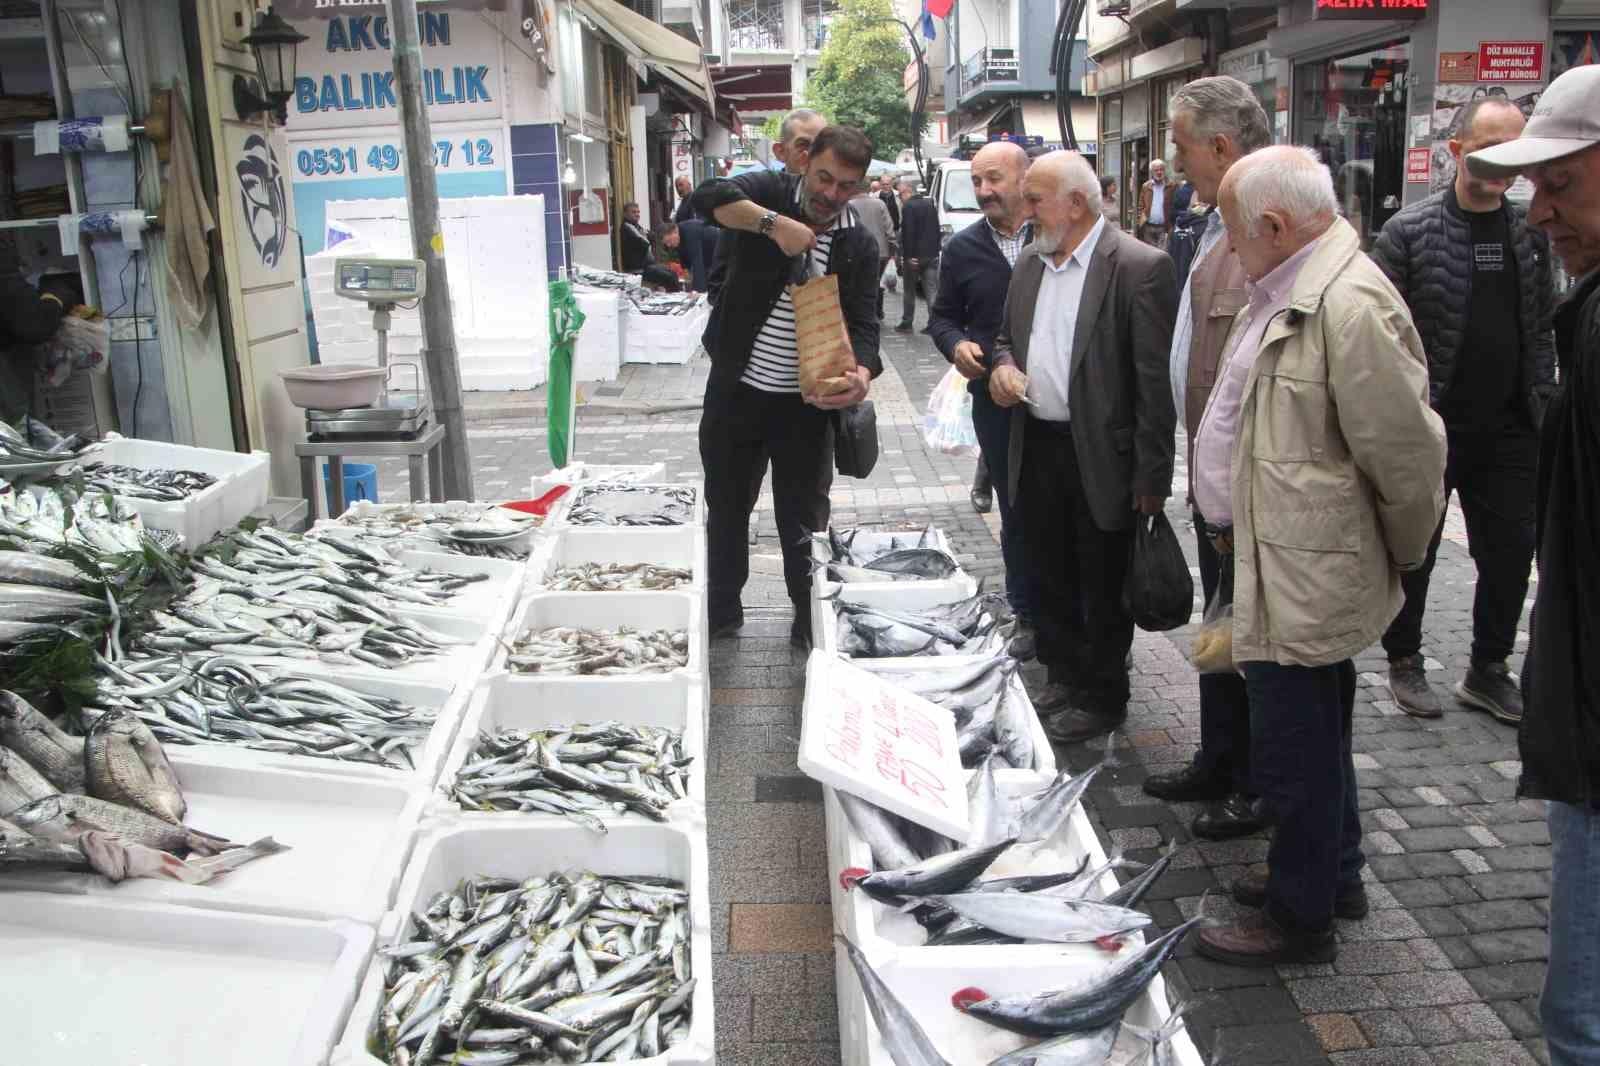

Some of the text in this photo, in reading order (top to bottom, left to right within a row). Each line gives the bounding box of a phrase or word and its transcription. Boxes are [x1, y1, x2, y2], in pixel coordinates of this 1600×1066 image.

[1502, 46, 1536, 56] MAHALLE
[295, 64, 492, 113] BALIKILIK
[297, 145, 358, 176] 0531
[366, 143, 400, 171] 49
[460, 138, 494, 166] 12
